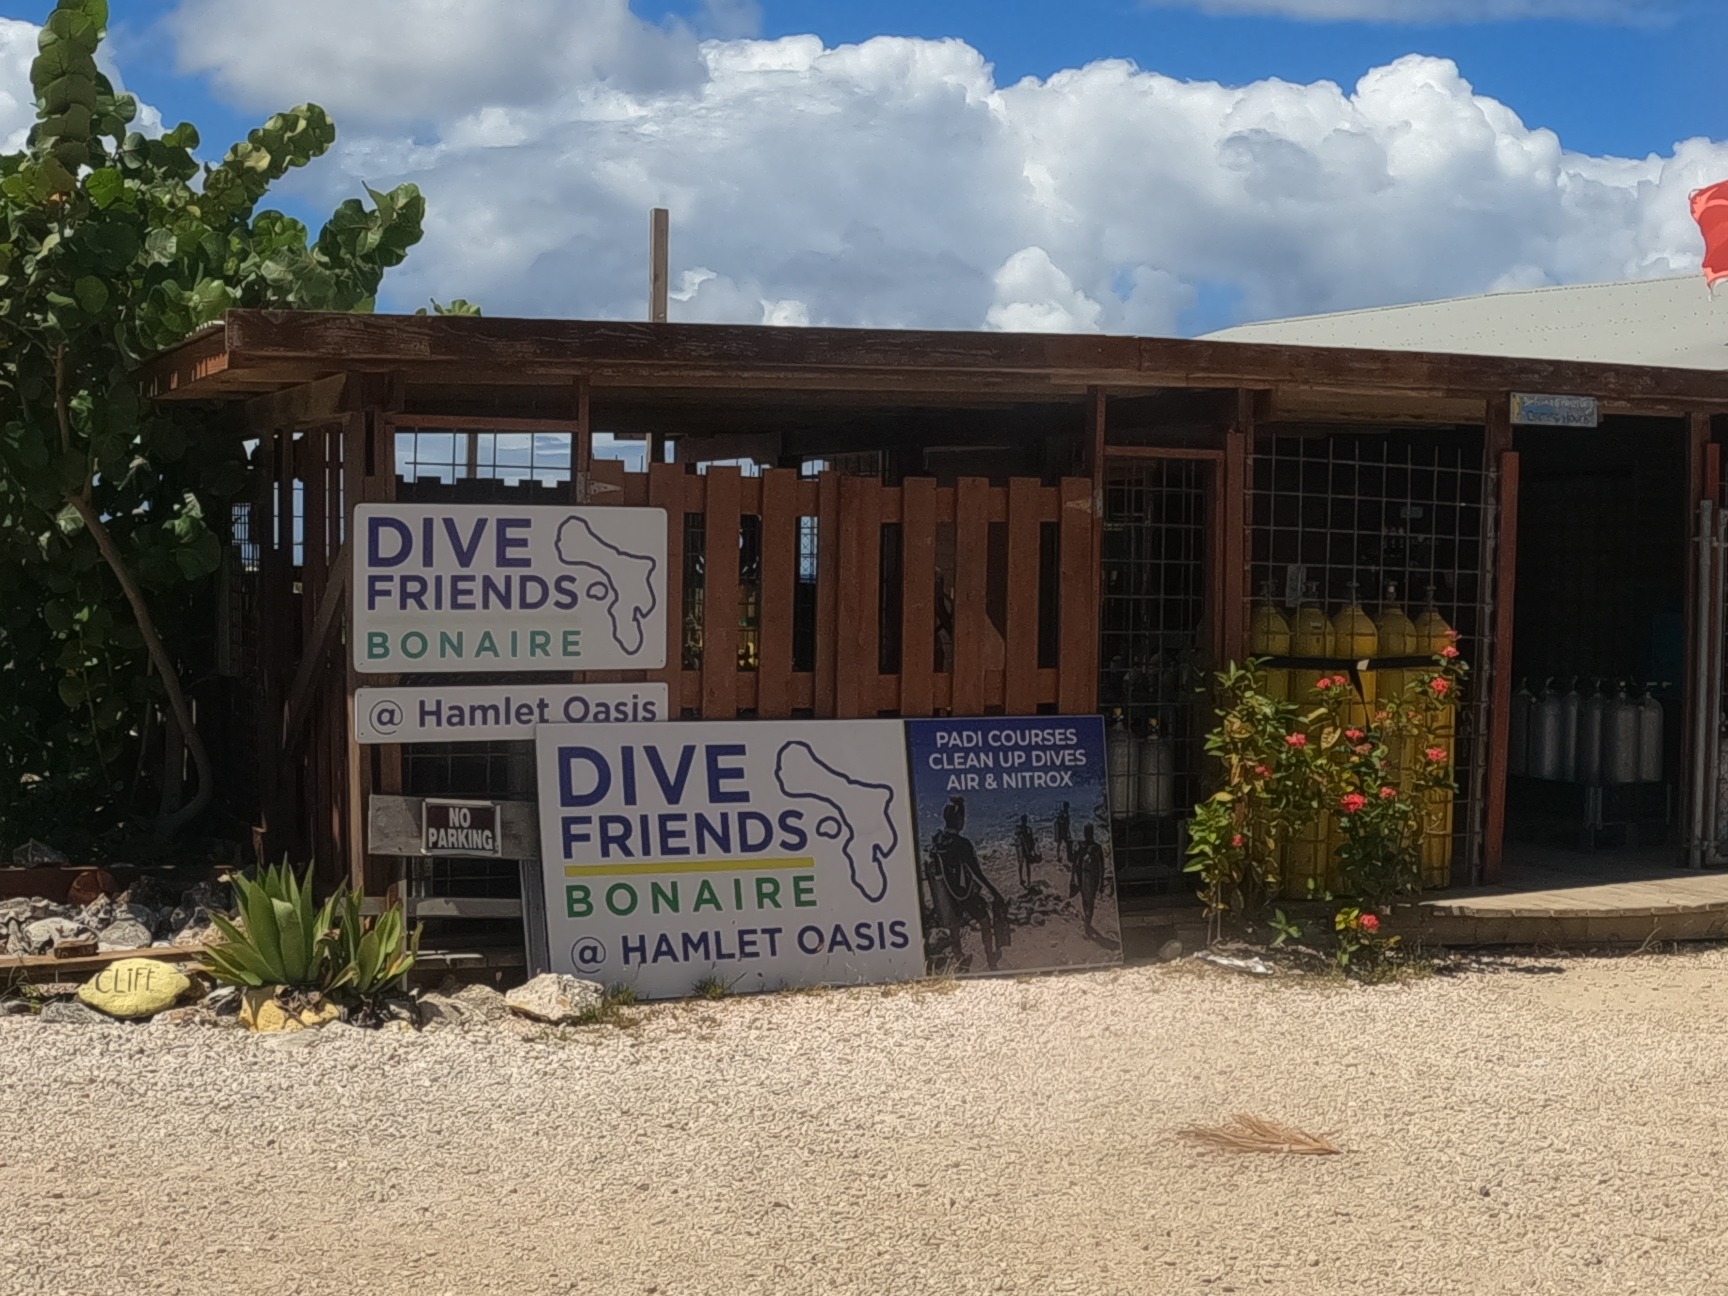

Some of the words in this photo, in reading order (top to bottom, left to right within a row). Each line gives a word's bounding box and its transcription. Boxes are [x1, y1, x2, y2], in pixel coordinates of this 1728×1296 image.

[367, 517, 532, 568] DIVE
[367, 574, 579, 611] FRIENDS
[367, 630, 582, 660] BONAIRE
[369, 699, 404, 735] @
[418, 696, 550, 729] Hamlet
[563, 694, 657, 722] Oasis
[935, 731, 983, 748] PADI
[987, 729, 1077, 746] COURSES
[557, 743, 751, 807] DIVE
[928, 752, 994, 770] CLEAN
[999, 751, 1026, 767] UP
[1032, 749, 1087, 767] DIVES
[946, 773, 980, 791] AIR
[984, 773, 998, 789] &
[1002, 771, 1073, 788] NITROX
[448, 807, 471, 828] NO
[561, 810, 808, 860] FRIENDS
[428, 827, 493, 850] PARKING
[565, 875, 818, 918] BONAIRE
[570, 936, 607, 974] @
[621, 928, 783, 965] HAMLET
[797, 921, 910, 955] OASIS
